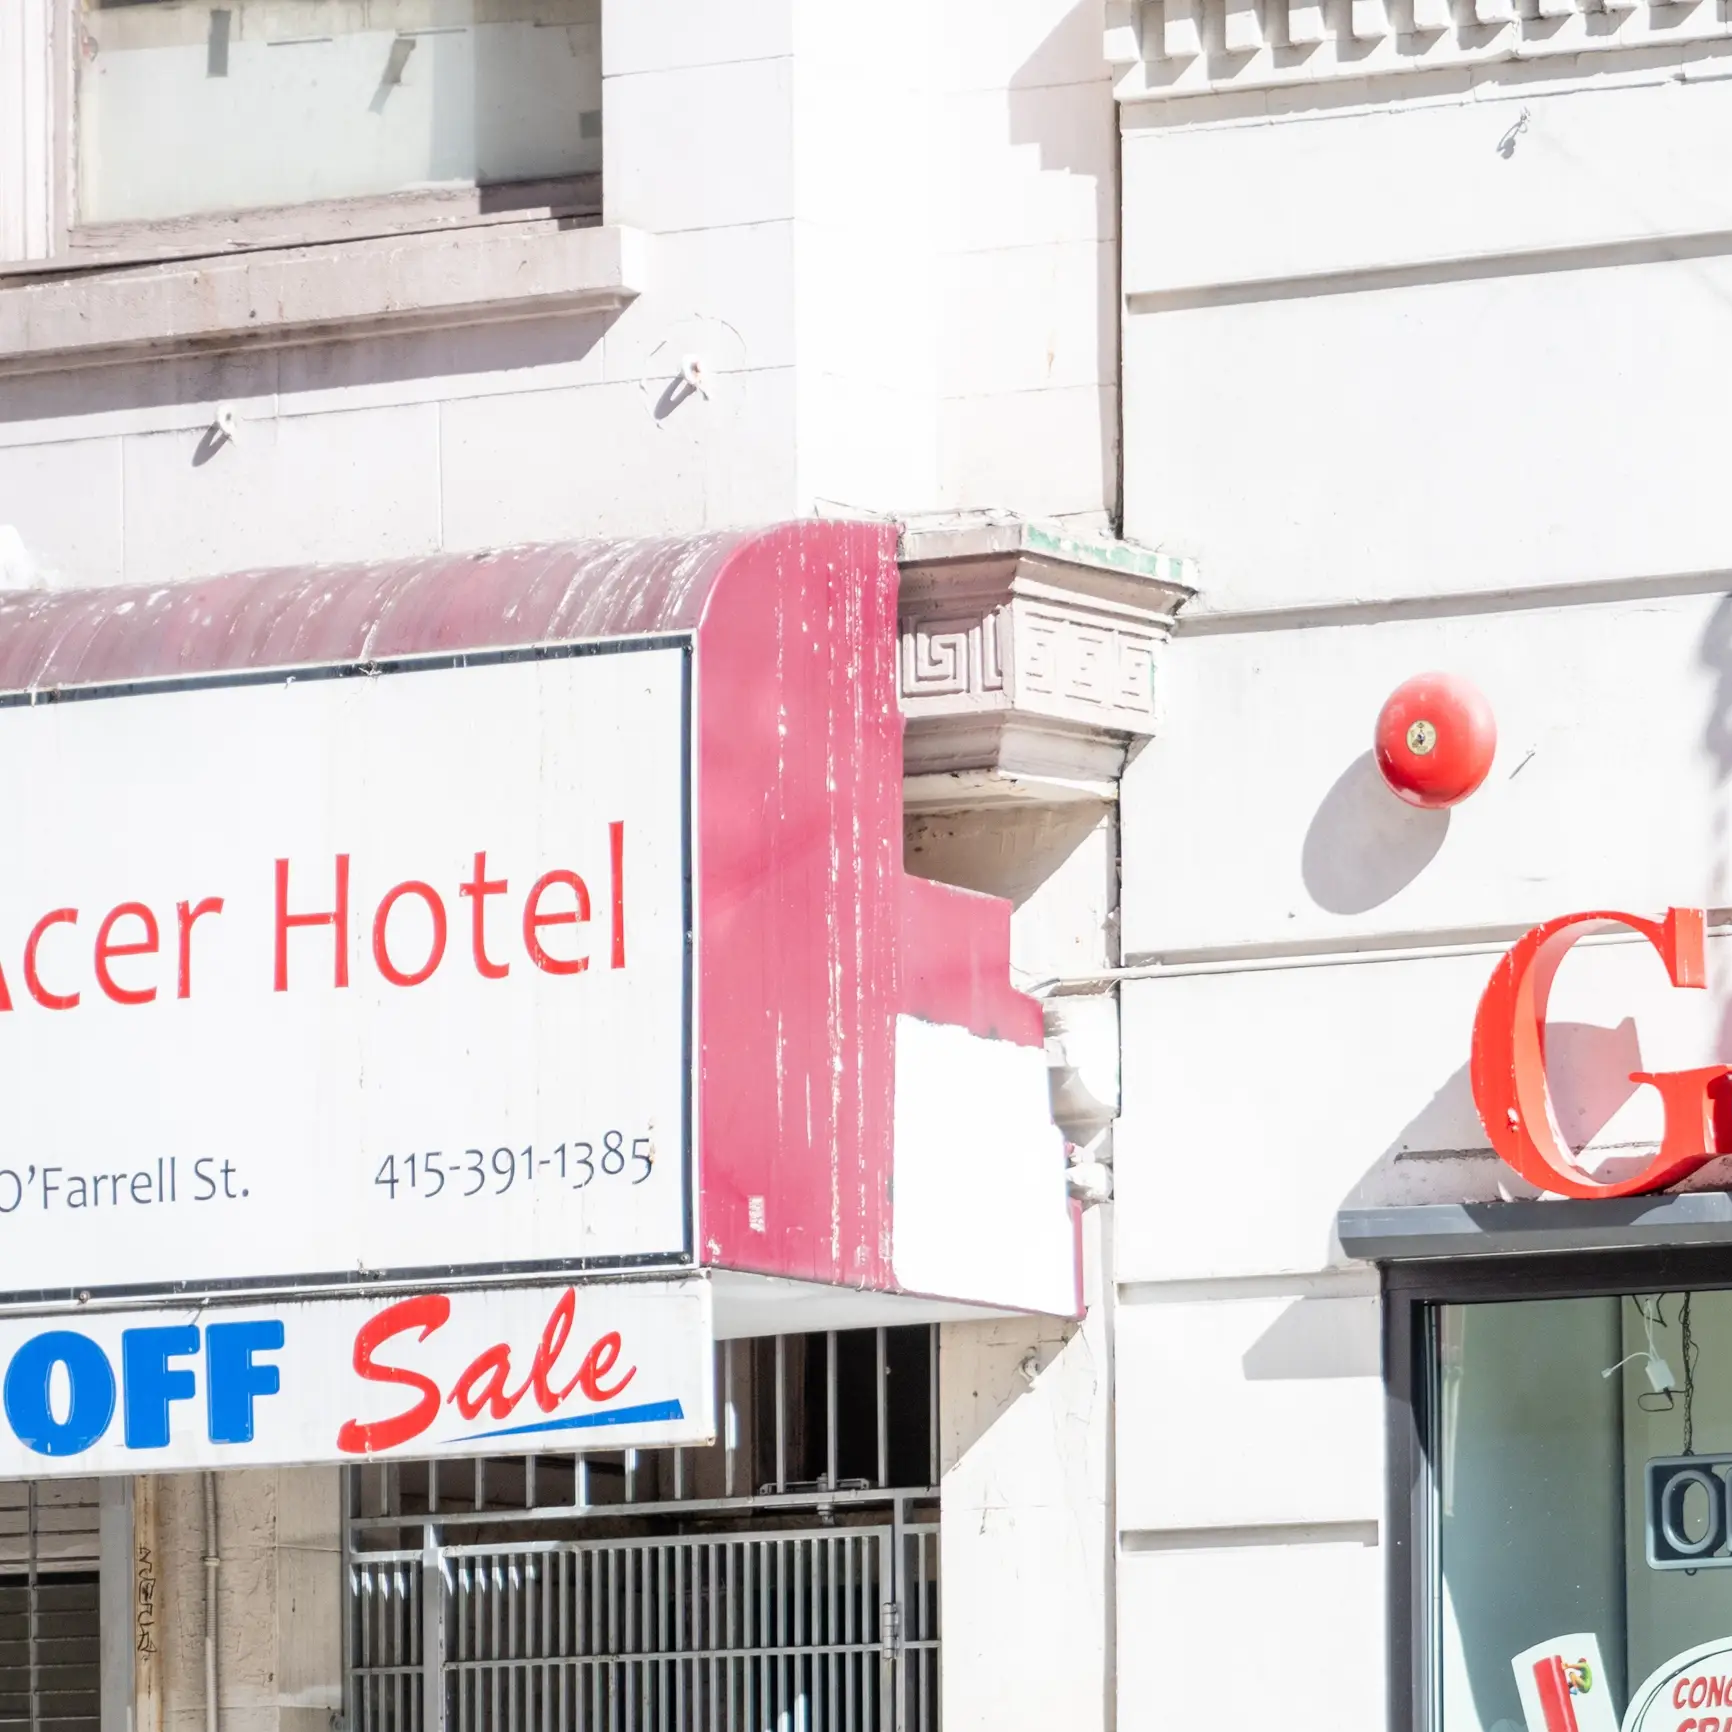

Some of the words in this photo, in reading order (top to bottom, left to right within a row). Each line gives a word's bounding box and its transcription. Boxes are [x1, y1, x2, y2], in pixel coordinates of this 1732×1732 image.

[0, 897, 225, 1012] cer
[273, 820, 626, 992] Hotel
[193, 1156, 251, 1202] St.
[374, 1129, 653, 1200] 415-391-1385
[3, 1319, 285, 1457] OFF
[336, 1287, 637, 1454] Sale
